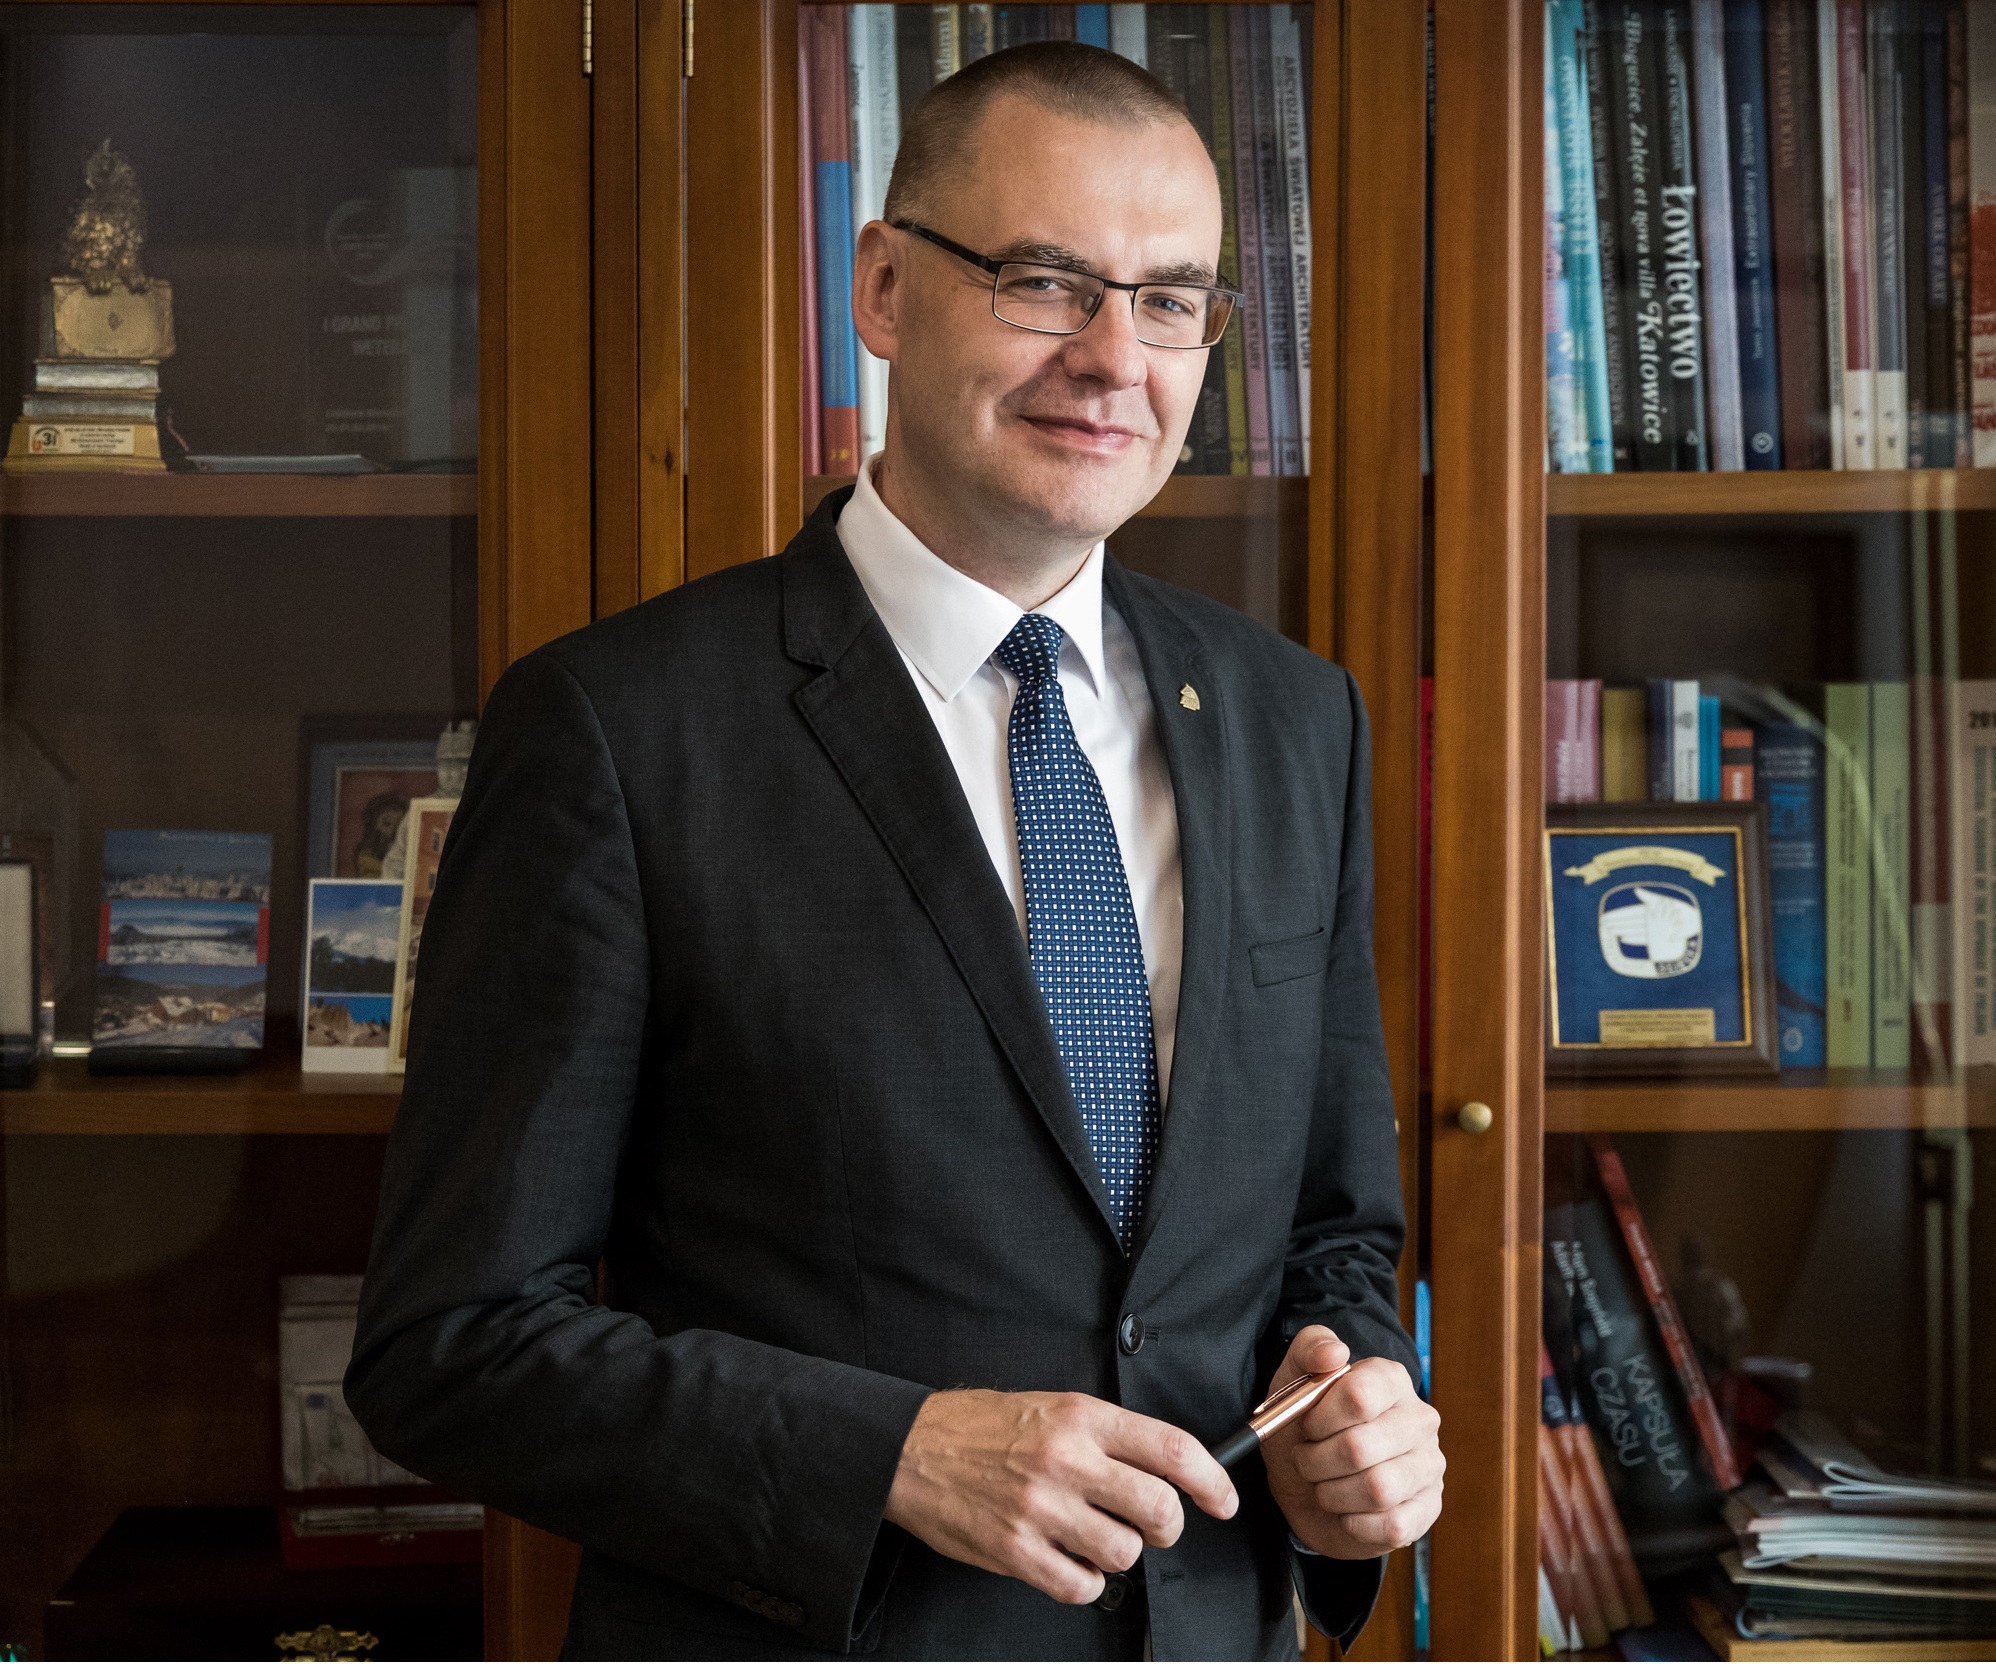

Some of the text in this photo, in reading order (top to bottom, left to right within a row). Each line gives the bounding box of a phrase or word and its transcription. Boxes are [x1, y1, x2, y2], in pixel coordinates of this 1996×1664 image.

[1282, 55, 1299, 149] ARCYDZIEŁA
[1234, 57, 1262, 371] ARCYDZIEŁA ŚWIATOWEJ ARCHITEKTURY
[1288, 155, 1306, 247] ŚWIATOWEJ
[1633, 187, 1651, 207] et
[1660, 183, 1702, 380] Łowiectwo
[1635, 300, 1668, 445] Katowice
[1589, 1366, 1647, 1468] CZASU
[1622, 1353, 1691, 1494] KAPSUŁA
